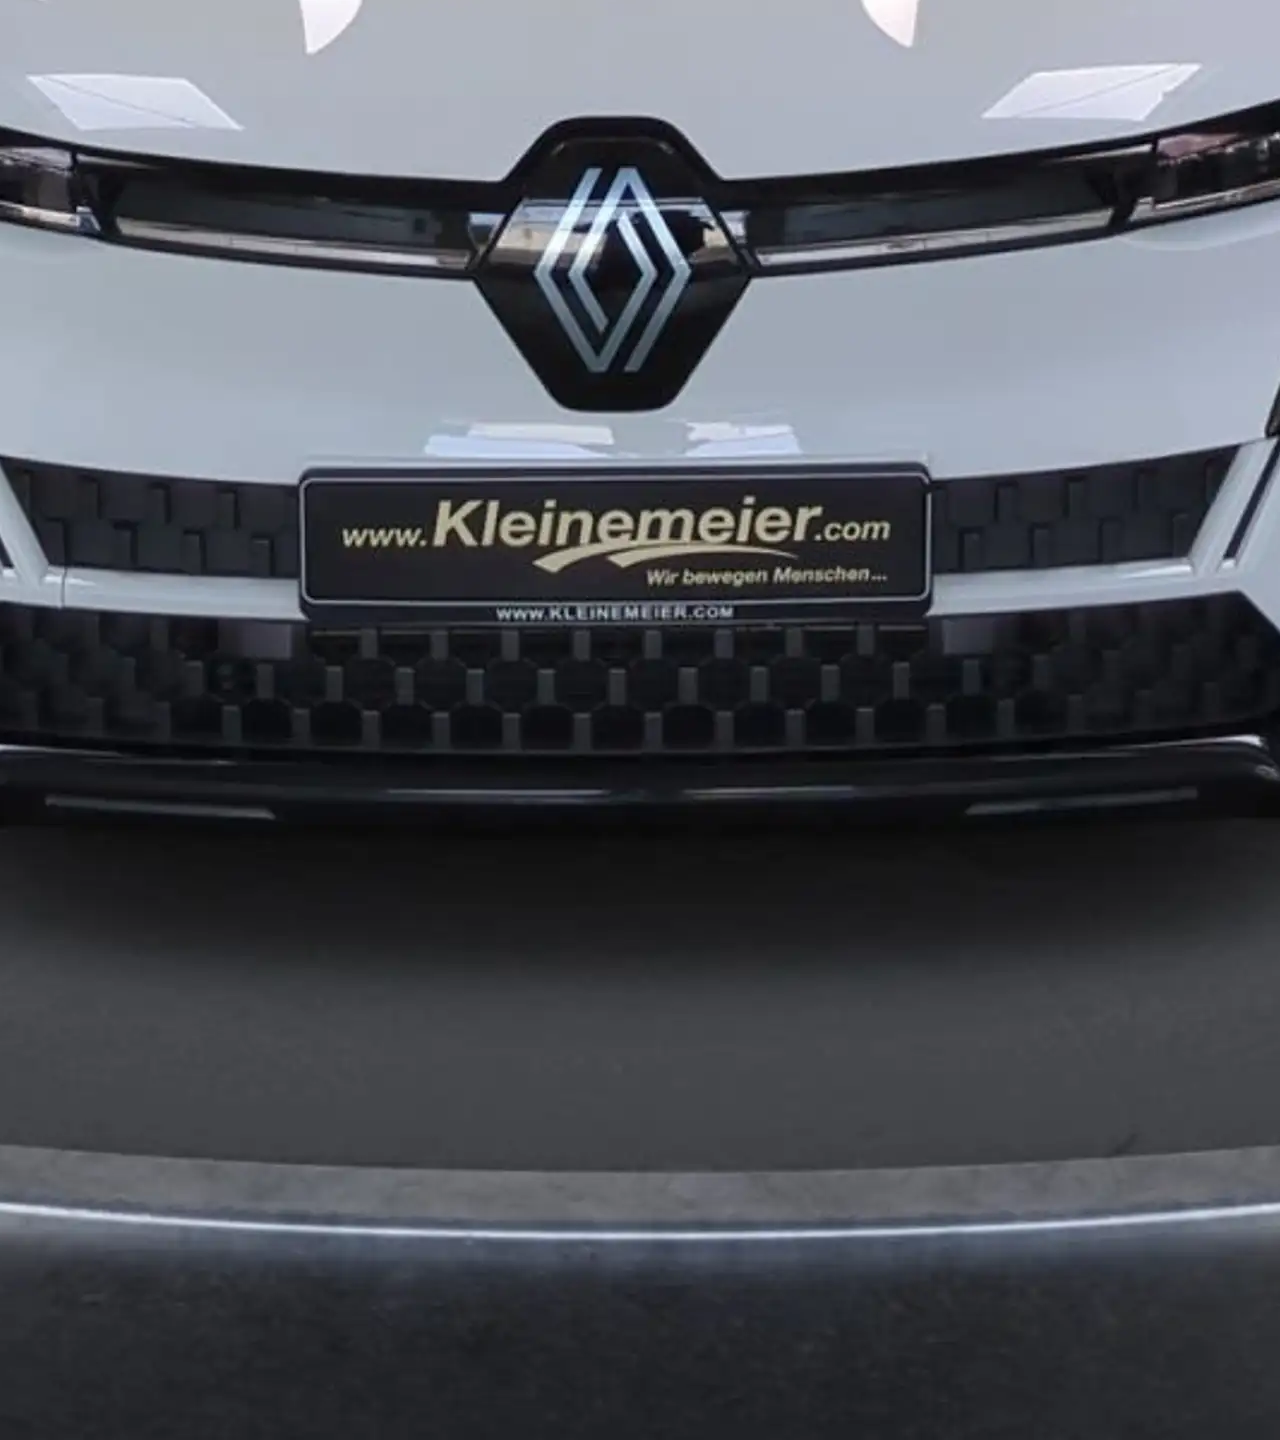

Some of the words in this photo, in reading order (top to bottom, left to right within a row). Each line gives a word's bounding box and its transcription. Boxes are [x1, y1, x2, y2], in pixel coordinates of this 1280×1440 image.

[342, 496, 890, 548] www.Kleinemeier.com
[646, 568, 679, 586] Wir
[683, 568, 768, 587] bewegen
[773, 566, 888, 583] Menschen...
